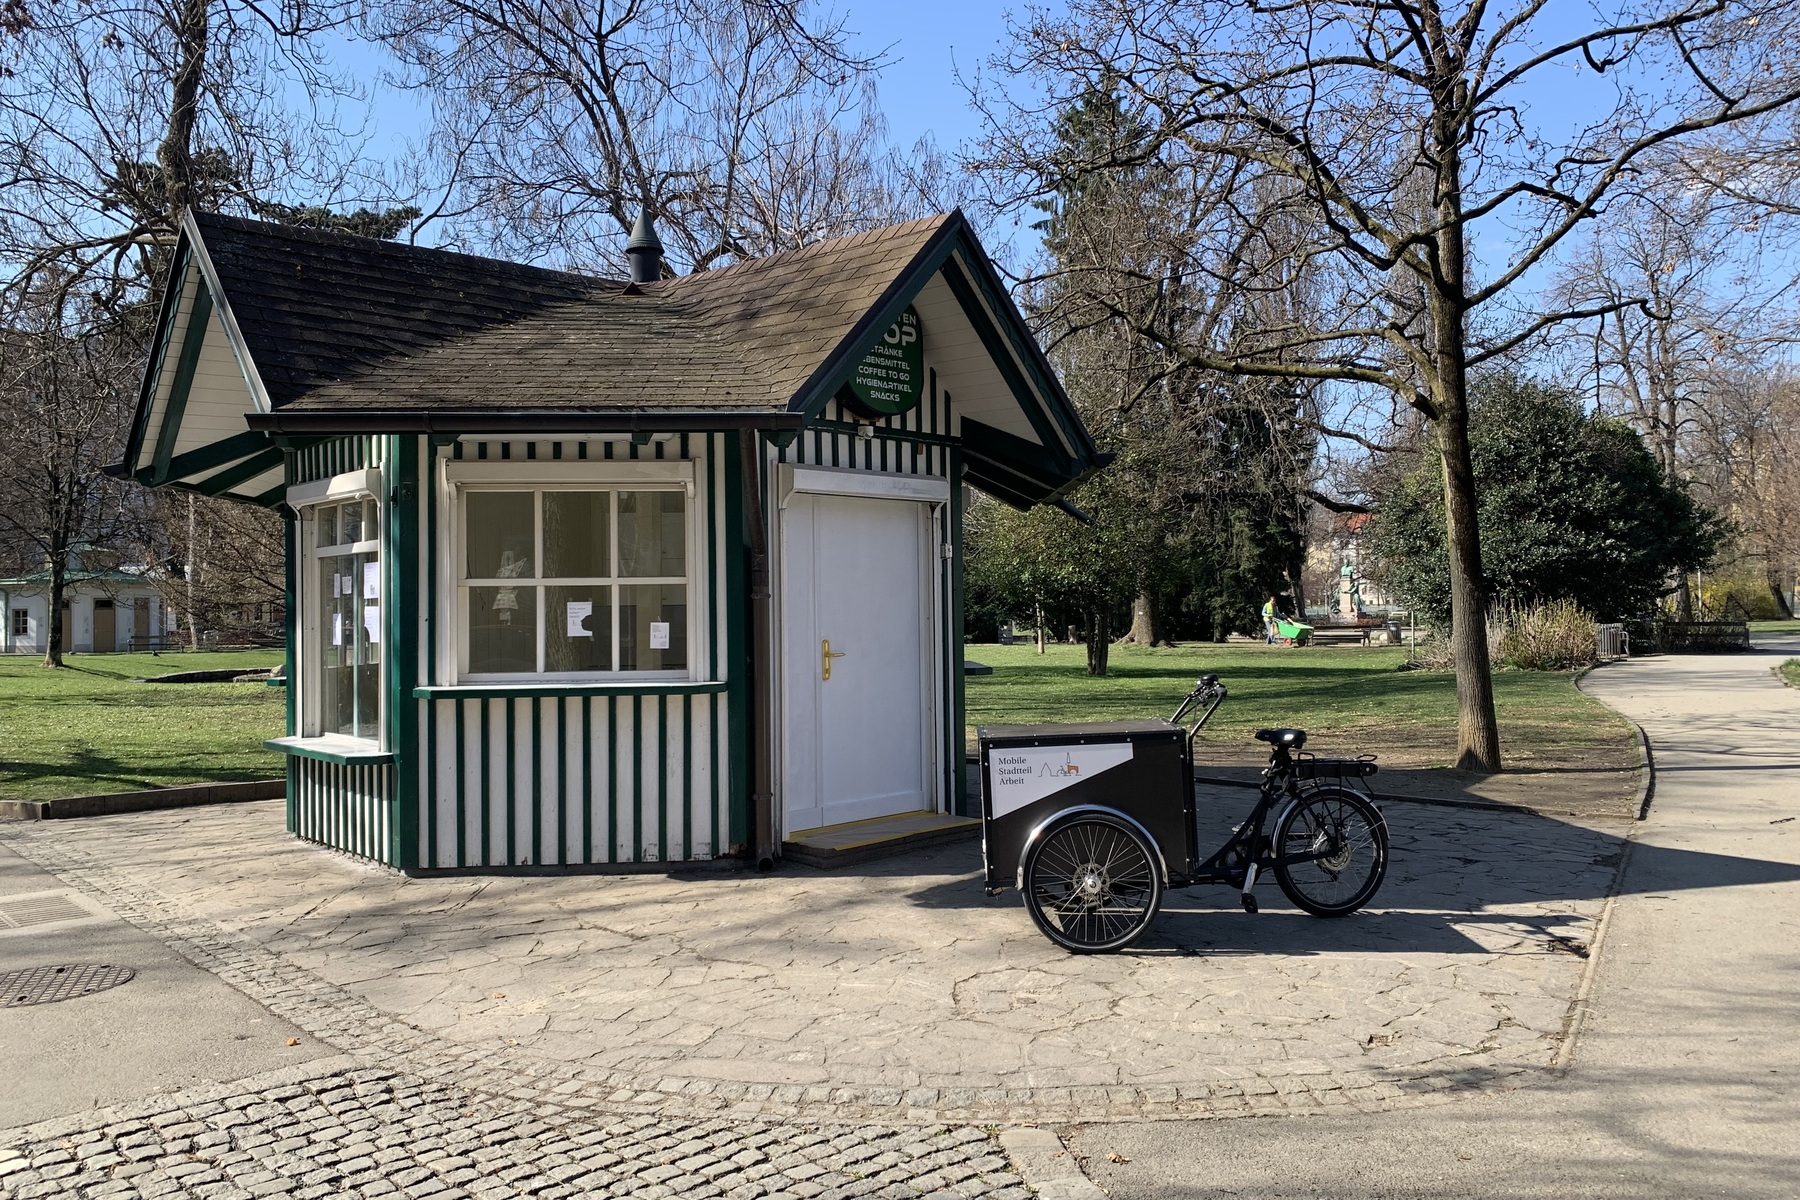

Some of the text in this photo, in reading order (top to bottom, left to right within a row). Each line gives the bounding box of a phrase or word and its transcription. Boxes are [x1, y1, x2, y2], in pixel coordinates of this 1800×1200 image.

[883, 323, 917, 346] OP
[871, 345, 903, 357] TRÄNKE
[863, 355, 910, 370] BENSMITTEL
[858, 365, 910, 381] COFFEE TO GO
[856, 376, 912, 392] HYGIENARTIKEL
[870, 390, 900, 401] SNACKS
[998, 756, 1027, 765] Mobile
[998, 766, 1032, 775] Stadtteil
[999, 777, 1024, 785] Arbeit
